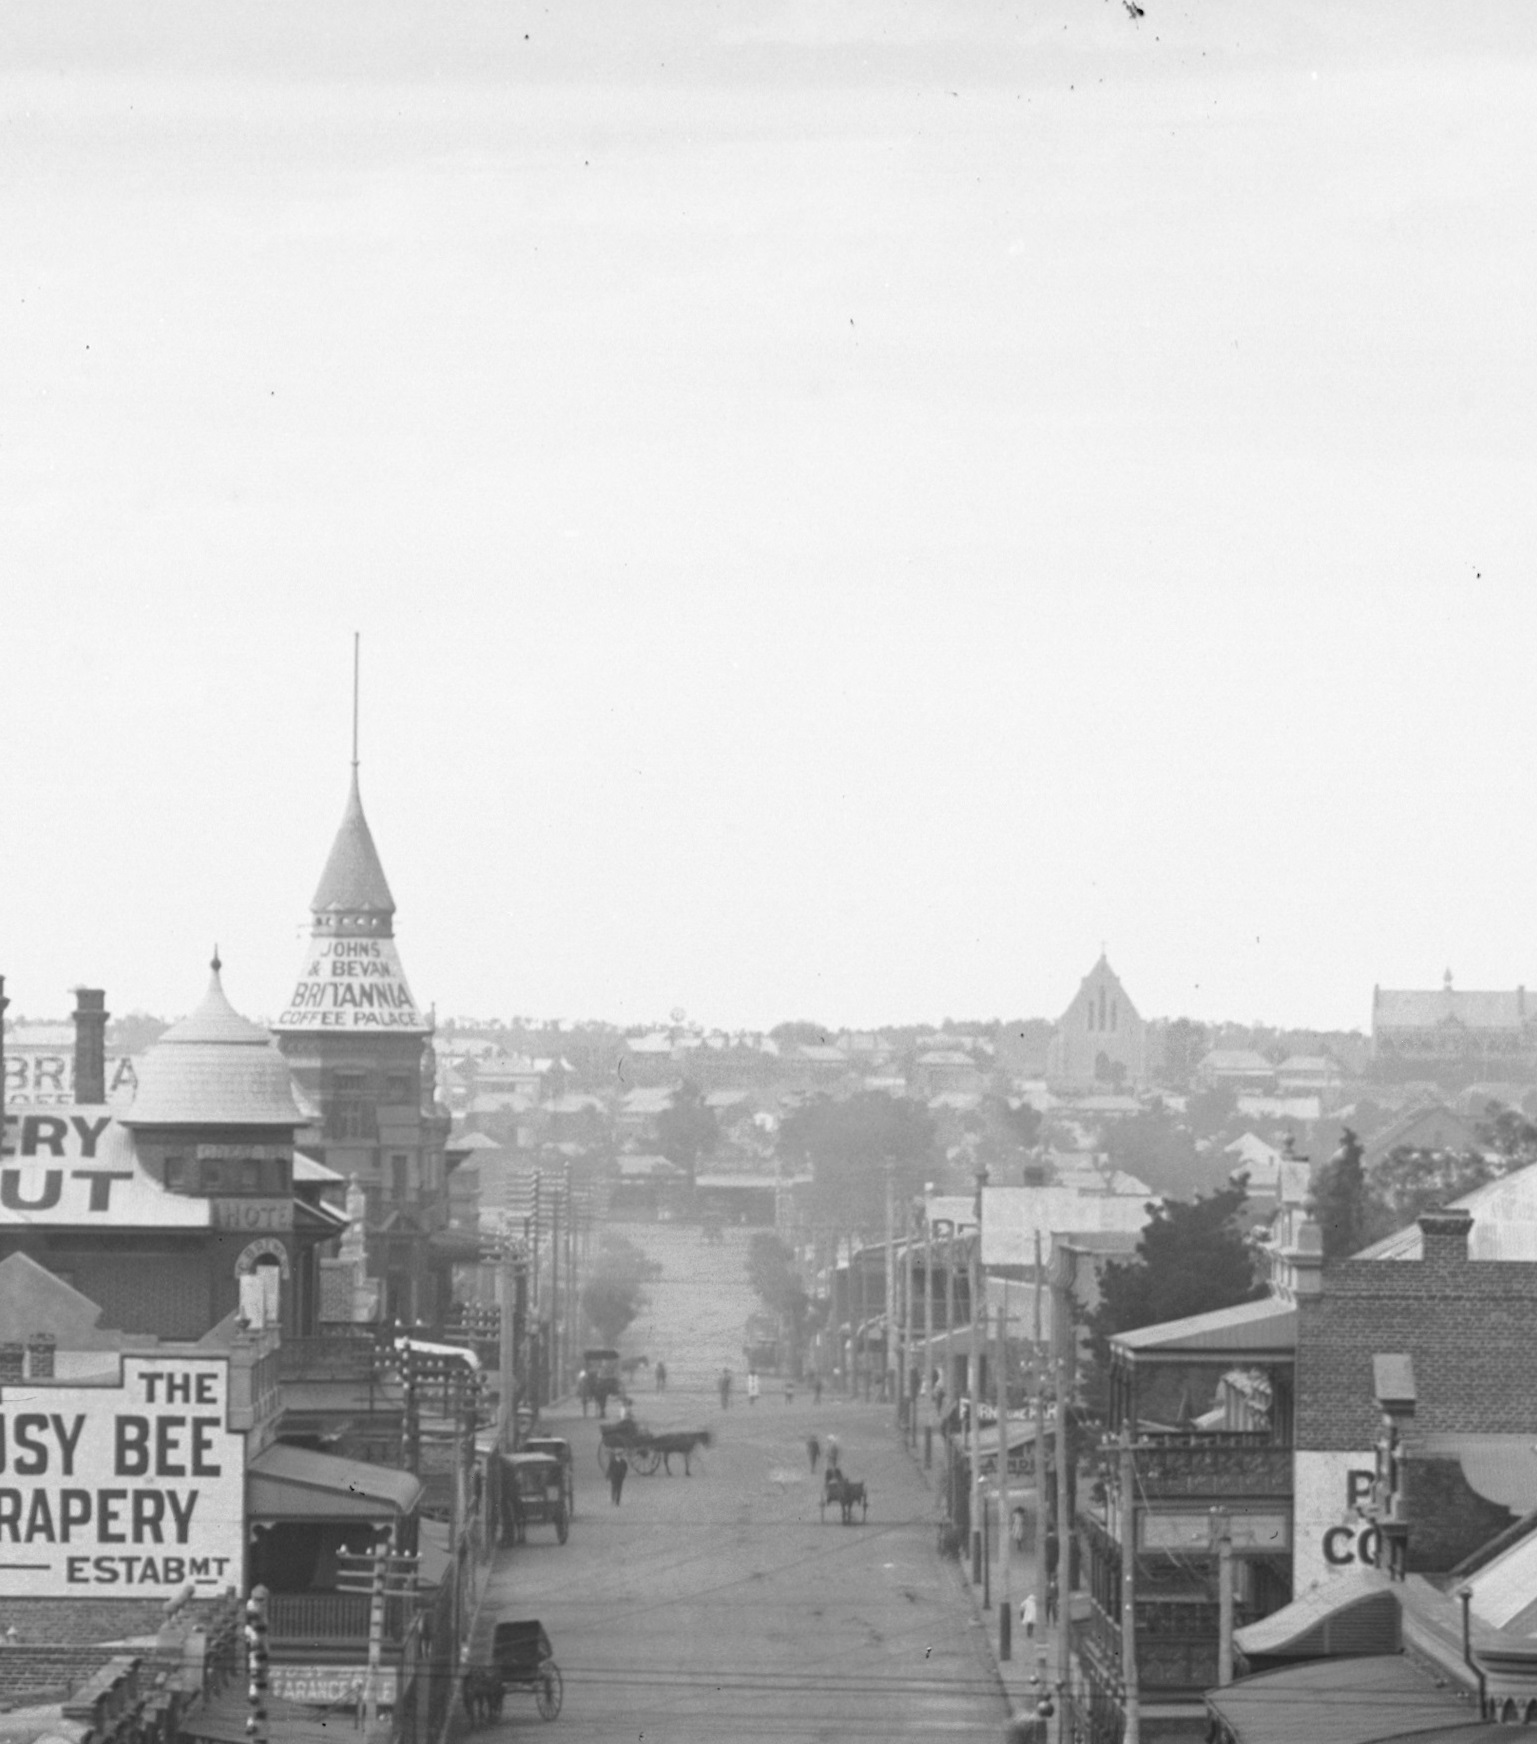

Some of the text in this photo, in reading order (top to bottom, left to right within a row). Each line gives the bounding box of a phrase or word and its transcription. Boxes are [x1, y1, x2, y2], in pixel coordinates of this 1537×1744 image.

[320, 941, 381, 958] JOHNS
[308, 960, 321, 977] &
[290, 981, 414, 1008] BRITANNIA
[278, 1010, 420, 1026] COFFEE PALACE
[223, 1203, 291, 1229] HOTE
[137, 1372, 219, 1404] THE
[114, 1414, 222, 1477] BEE
